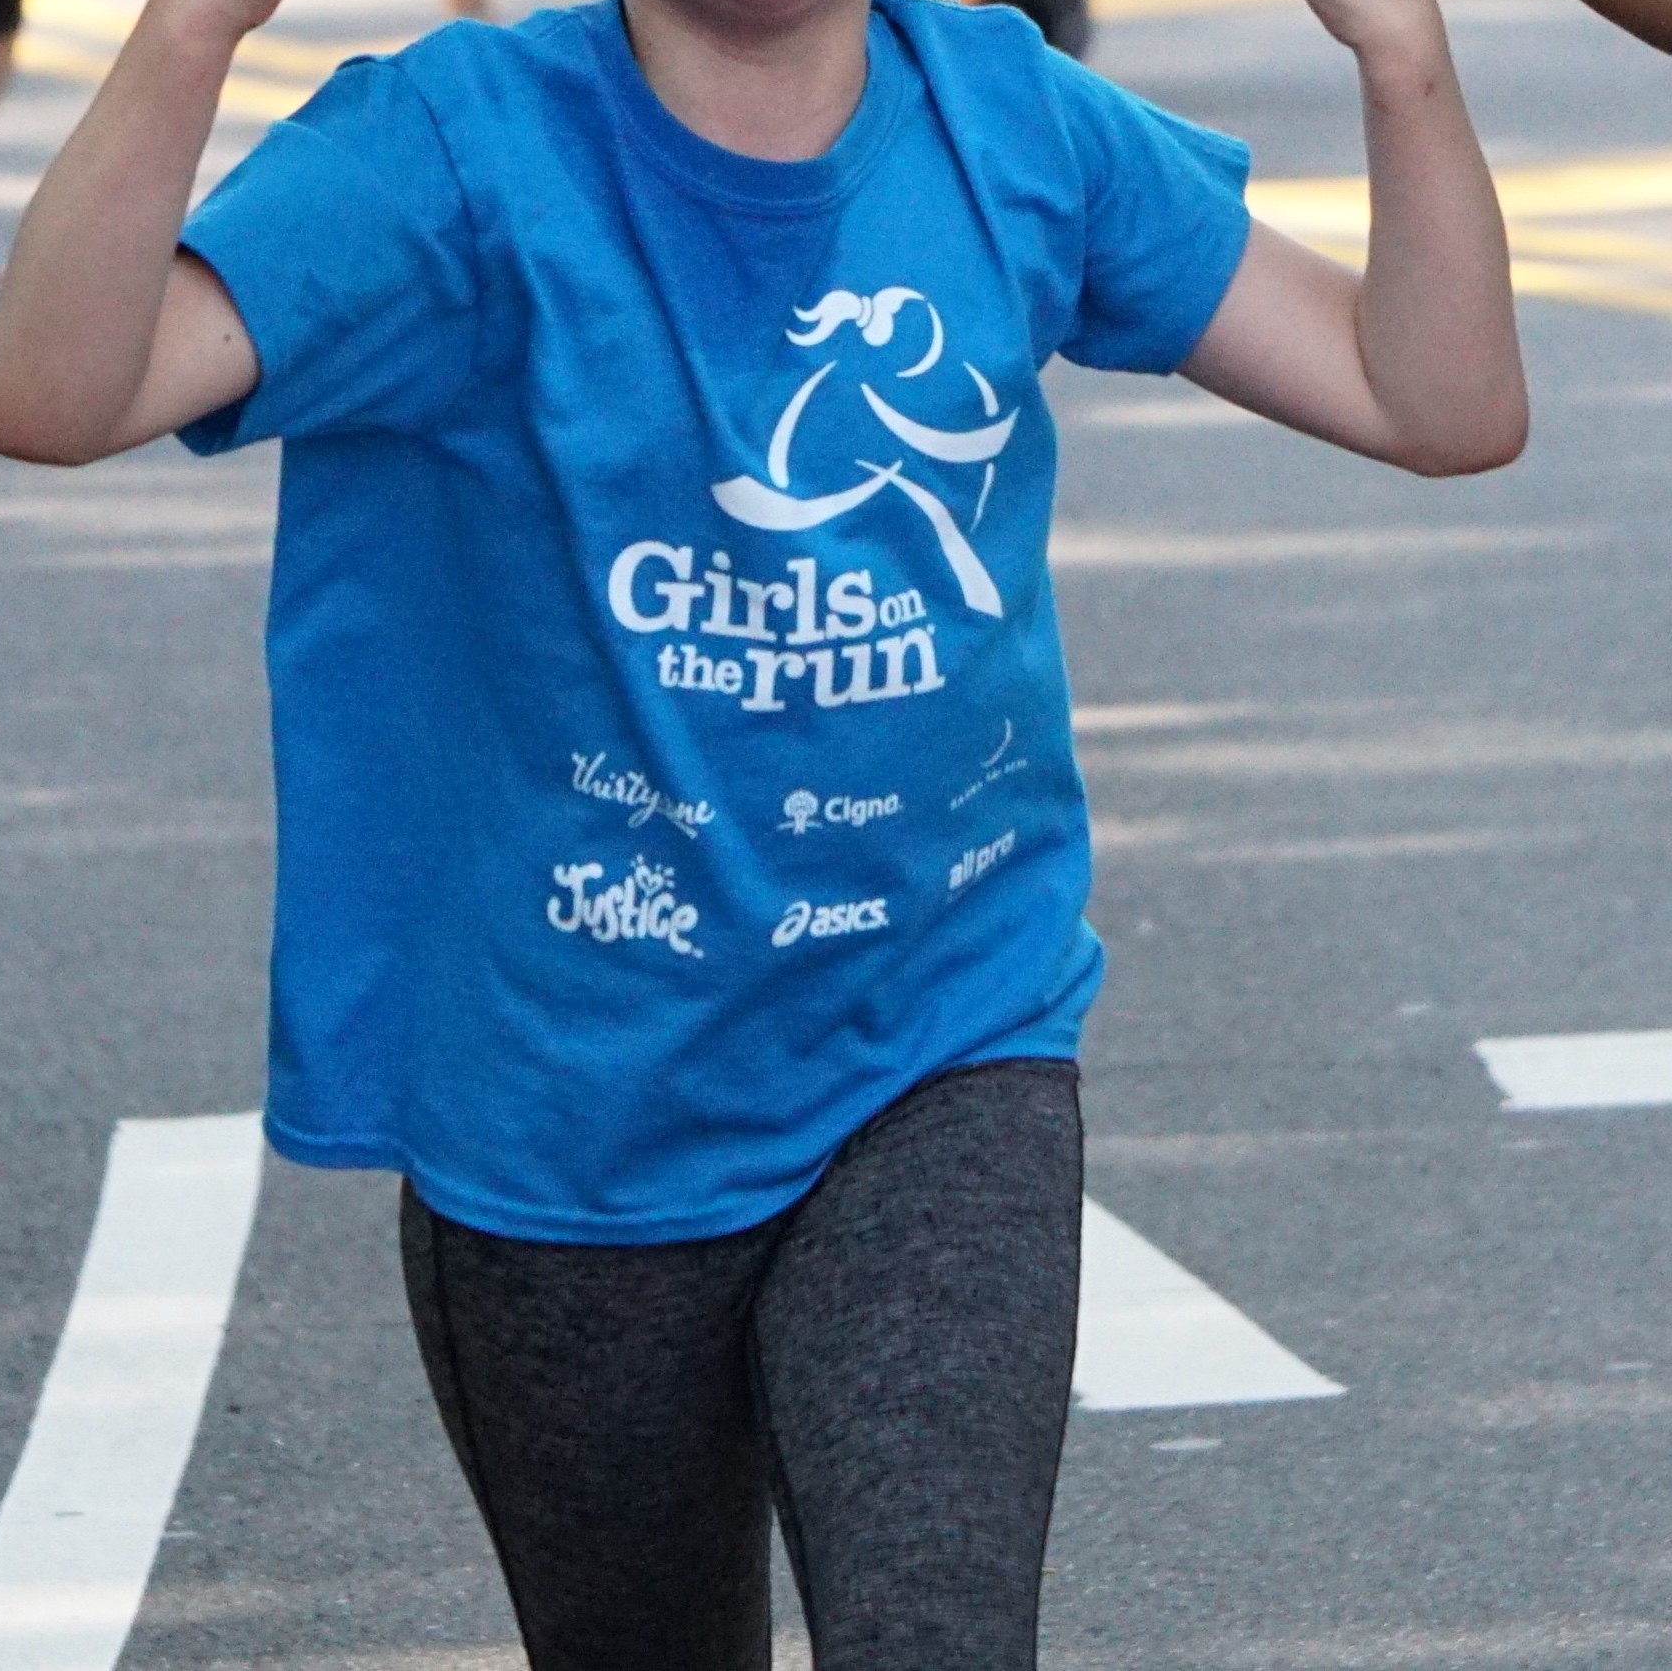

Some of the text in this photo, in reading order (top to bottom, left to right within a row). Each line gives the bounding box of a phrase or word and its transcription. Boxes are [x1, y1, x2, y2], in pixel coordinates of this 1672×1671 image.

[608, 539, 927, 646] Girls on
[657, 627, 945, 712] the run
[824, 792, 900, 827] Cigna
[949, 829, 1016, 890] all pro
[547, 858, 699, 956] Justice
[810, 897, 887, 938] asics
